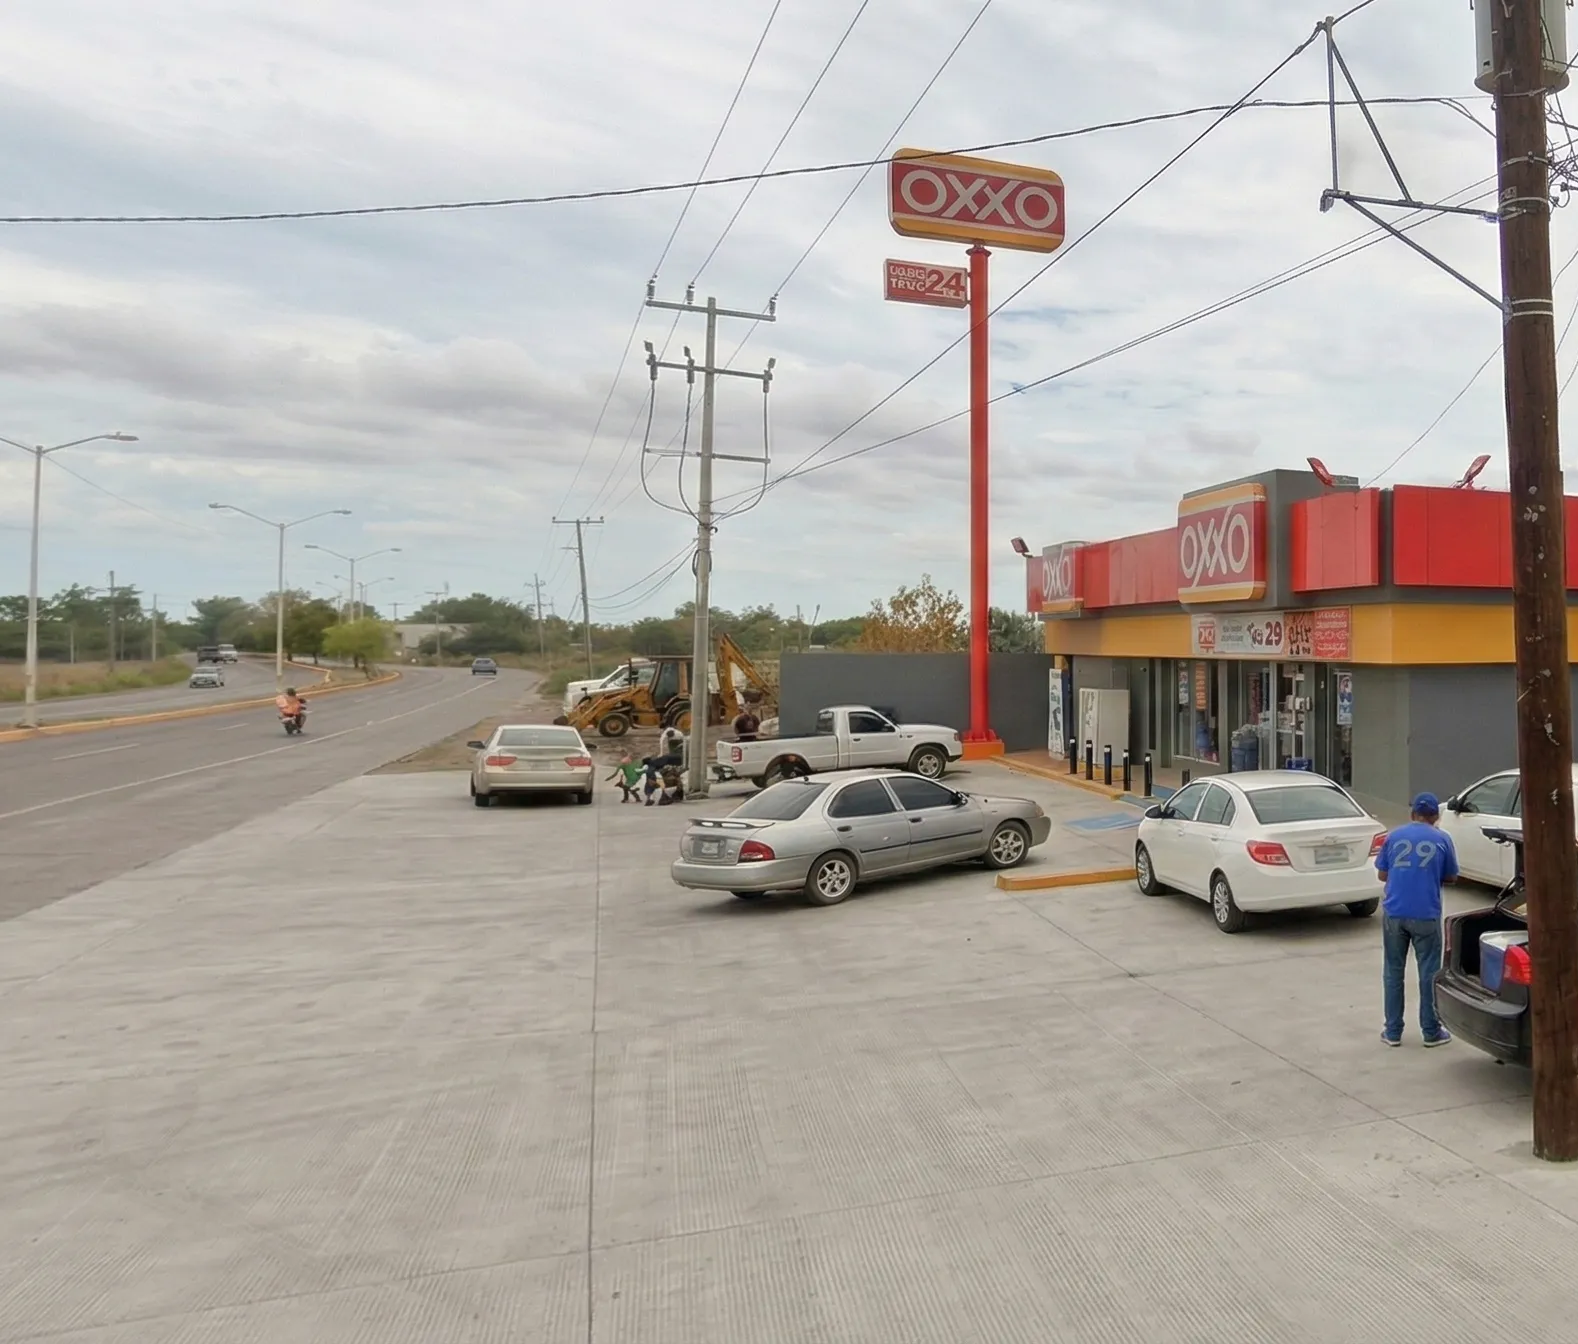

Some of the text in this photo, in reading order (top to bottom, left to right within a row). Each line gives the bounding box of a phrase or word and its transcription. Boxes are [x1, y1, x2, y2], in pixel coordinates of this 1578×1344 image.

[901, 169, 1058, 229] OXXO
[924, 269, 966, 297] 24
[1181, 504, 1250, 589] OXXO
[1042, 545, 1072, 601] OXXO
[1265, 621, 1283, 647] 29
[1392, 838, 1437, 868] 29
